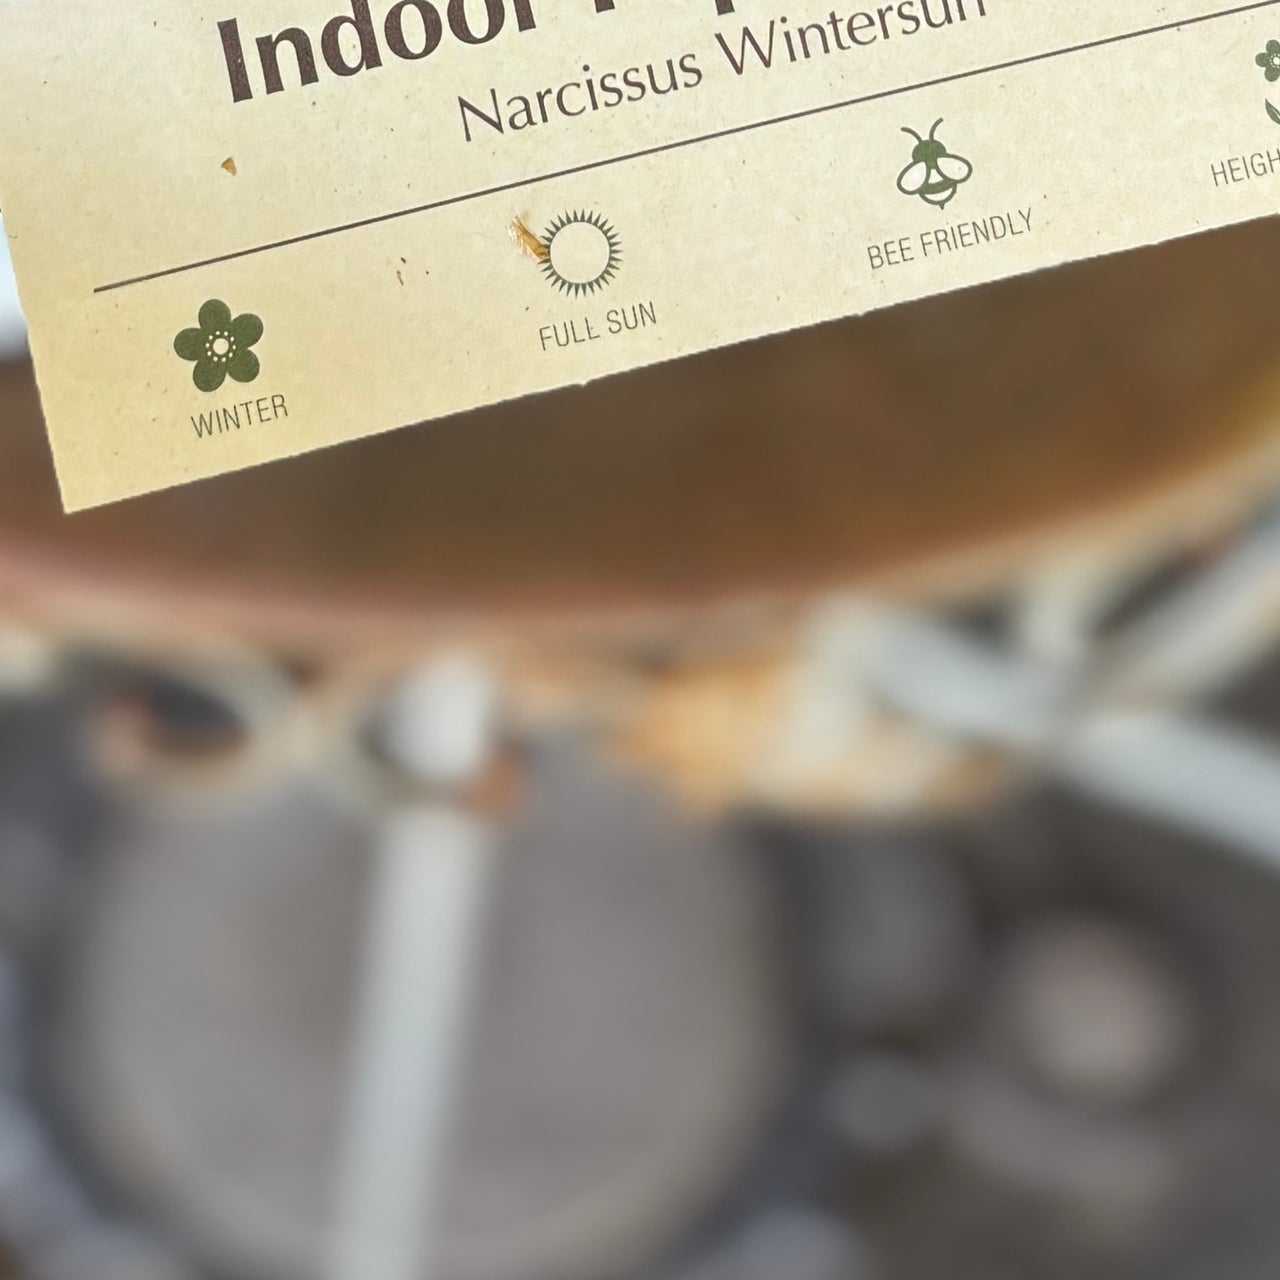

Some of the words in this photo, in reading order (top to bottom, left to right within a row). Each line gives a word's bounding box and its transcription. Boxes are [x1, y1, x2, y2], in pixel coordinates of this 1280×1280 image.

[457, 54, 705, 143] Narcissus
[867, 237, 916, 270] BEE
[921, 207, 1034, 257] FRIENDLY
[539, 317, 600, 351] FULL
[606, 302, 658, 338] SUN
[191, 393, 289, 439] WINTER
